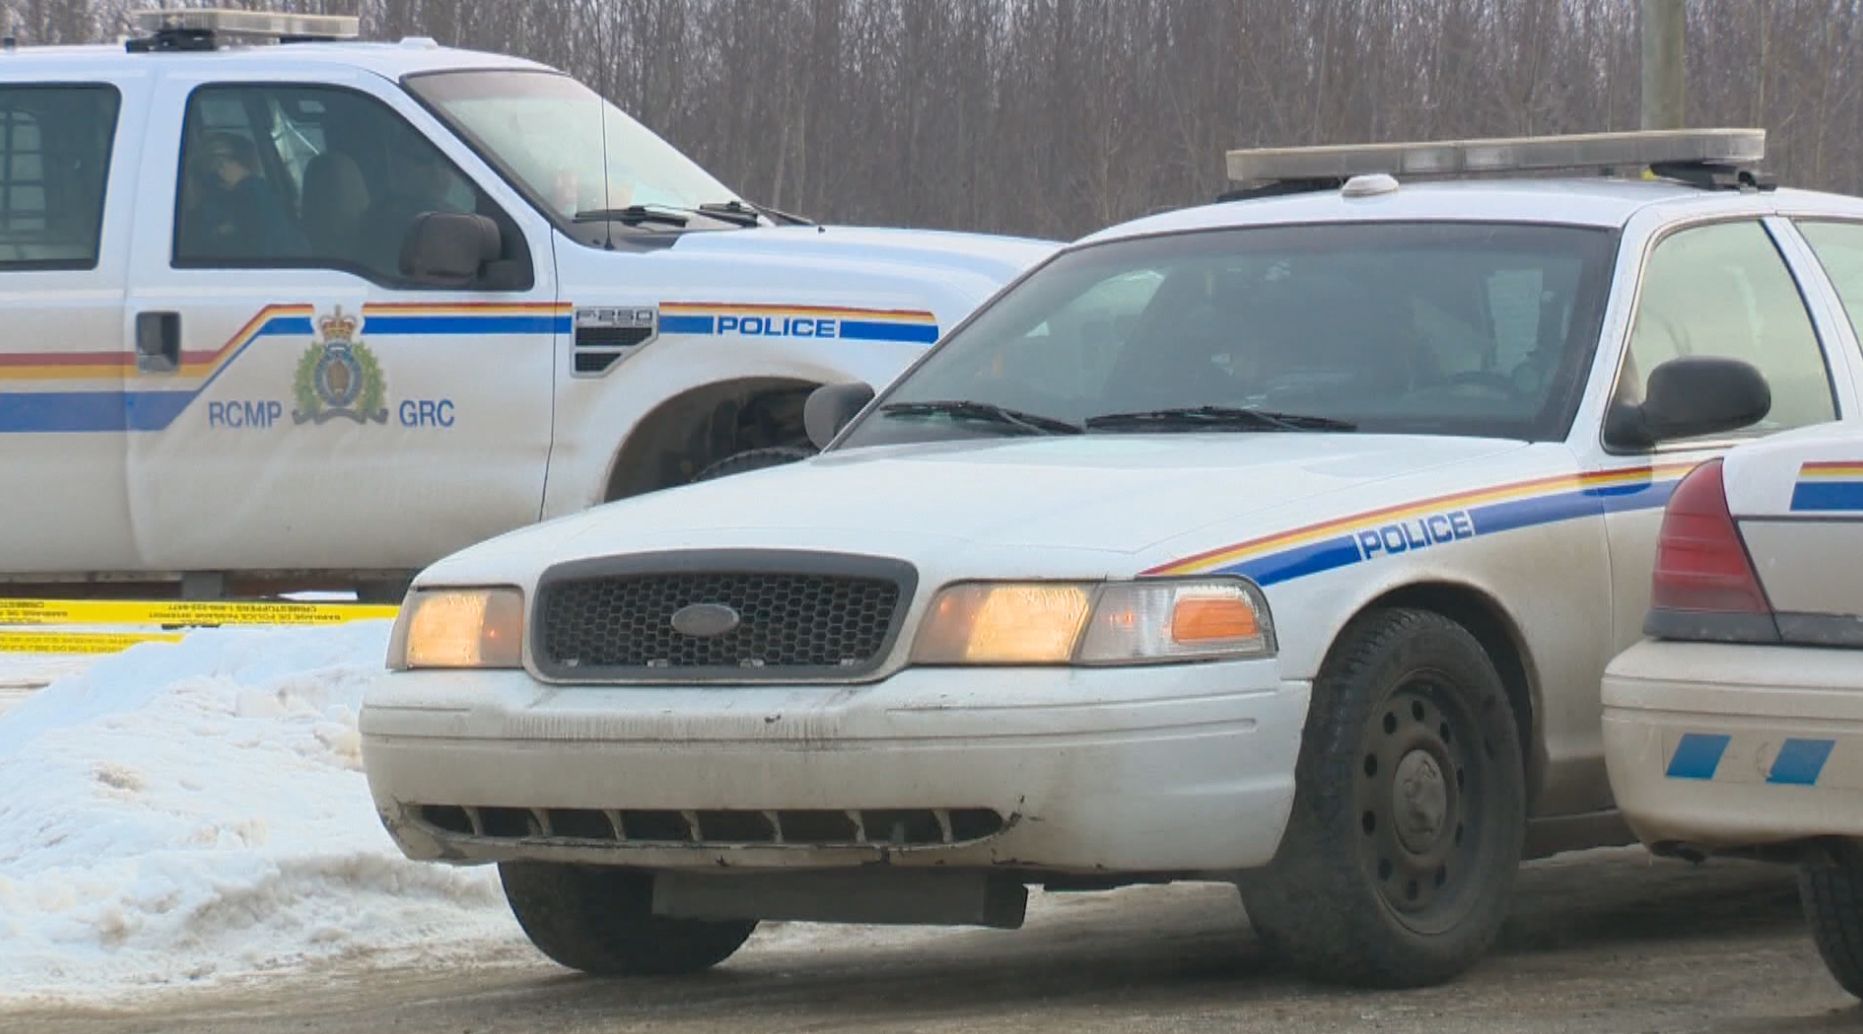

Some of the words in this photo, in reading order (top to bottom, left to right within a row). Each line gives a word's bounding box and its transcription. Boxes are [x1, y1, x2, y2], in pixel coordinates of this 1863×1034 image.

[717, 316, 836, 338] POLICE
[208, 401, 282, 428] RCMP
[400, 400, 455, 427] GRC
[1358, 510, 1474, 561] POLICE
